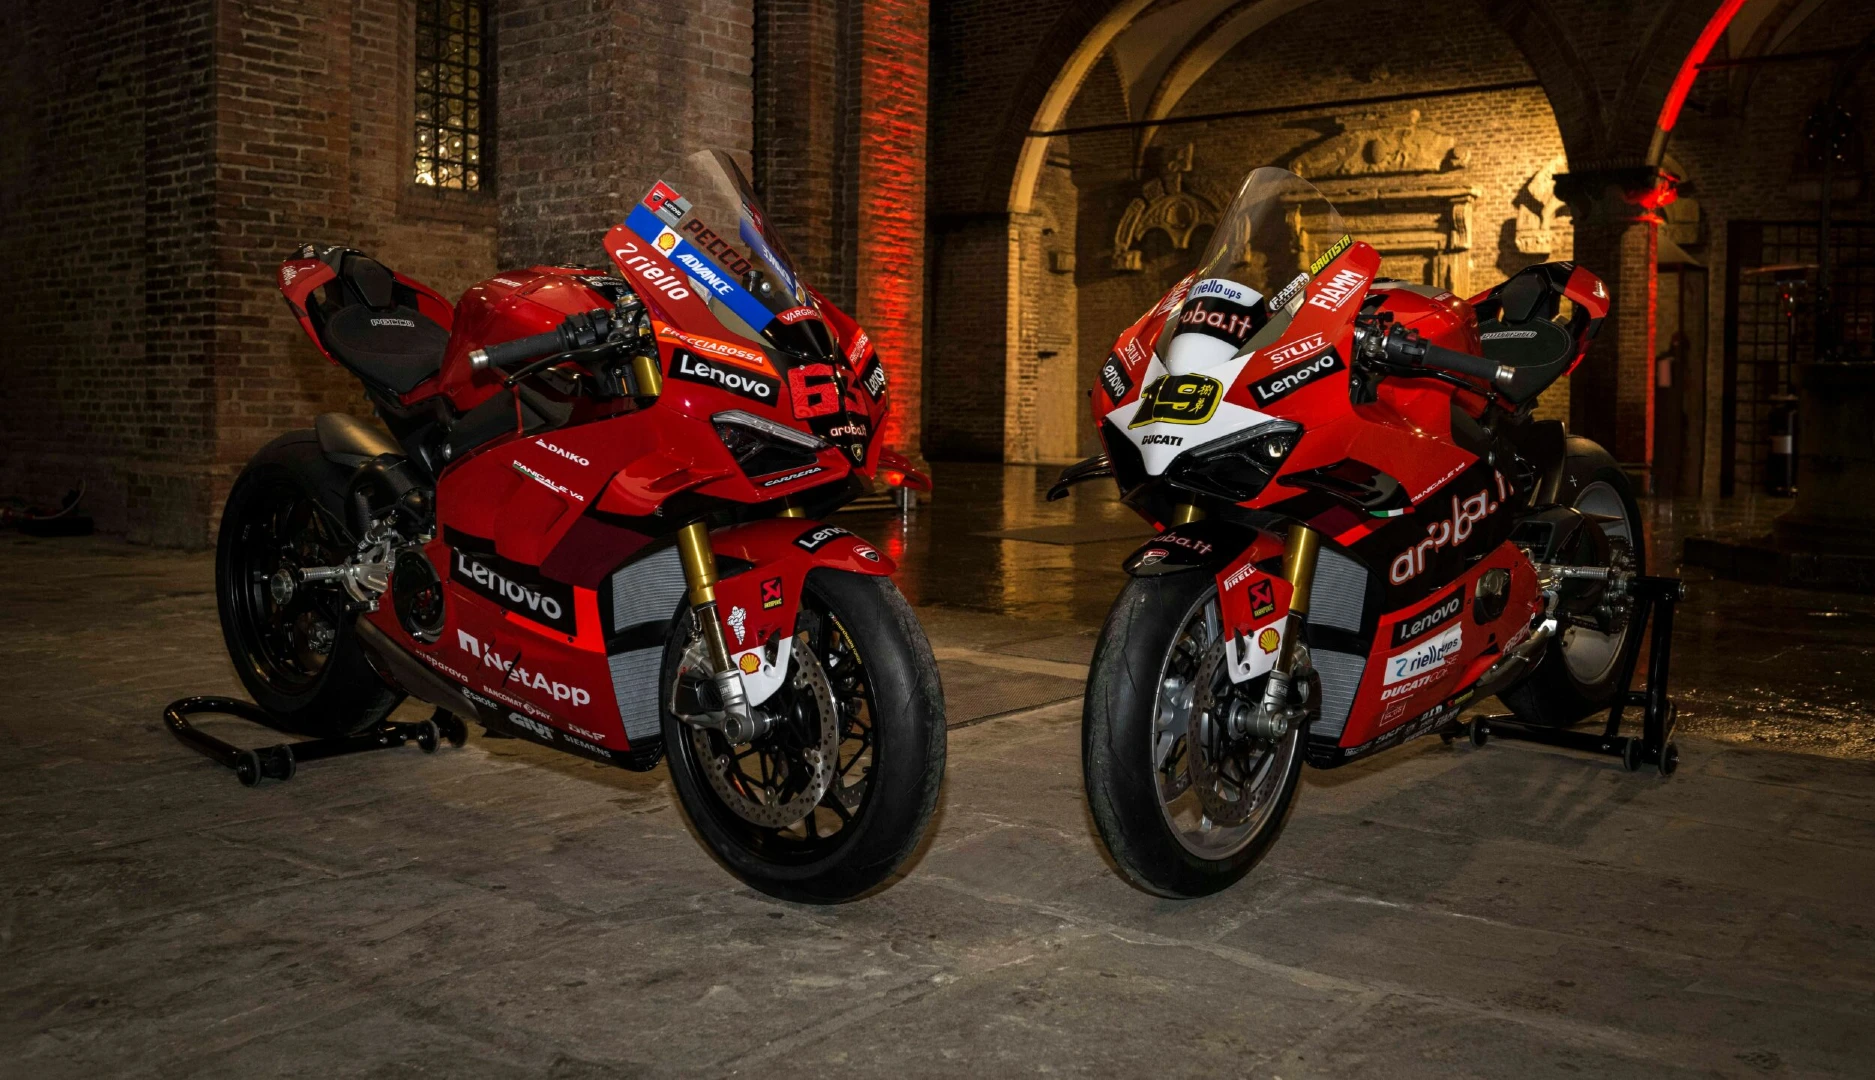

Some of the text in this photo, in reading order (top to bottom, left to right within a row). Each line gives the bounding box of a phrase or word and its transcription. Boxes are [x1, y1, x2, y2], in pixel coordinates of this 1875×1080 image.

[664, 200, 682, 216] Lenovo
[683, 218, 751, 276] PECCO
[1310, 234, 1351, 275] BAUTISTA
[625, 255, 689, 300] riello
[676, 253, 733, 295] ADVANCE
[1193, 279, 1242, 300] riello ups
[1308, 269, 1364, 311] FIAMM
[1181, 300, 1252, 339] uba.it
[661, 327, 763, 364] FRECCIAROSSA
[1124, 341, 1142, 366] STULZ
[1270, 337, 1326, 364] STULZ
[680, 354, 770, 398] Lenovo
[1257, 355, 1335, 400] Lenovo
[1127, 372, 1223, 430] 19
[548, 443, 590, 467] DAIKO
[1141, 434, 1184, 447] DUCATI
[513, 460, 584, 502] PANIGALE V4
[764, 466, 822, 487] CARRERA
[1152, 532, 1212, 555] uba.it
[454, 547, 562, 620] Lenovo
[1400, 597, 1460, 641] Lenovo
[1410, 637, 1459, 673] riello ups
[484, 643, 591, 707] NetApp
[1381, 675, 1431, 700] DUCATI
[563, 734, 611, 758] SIEMENS
